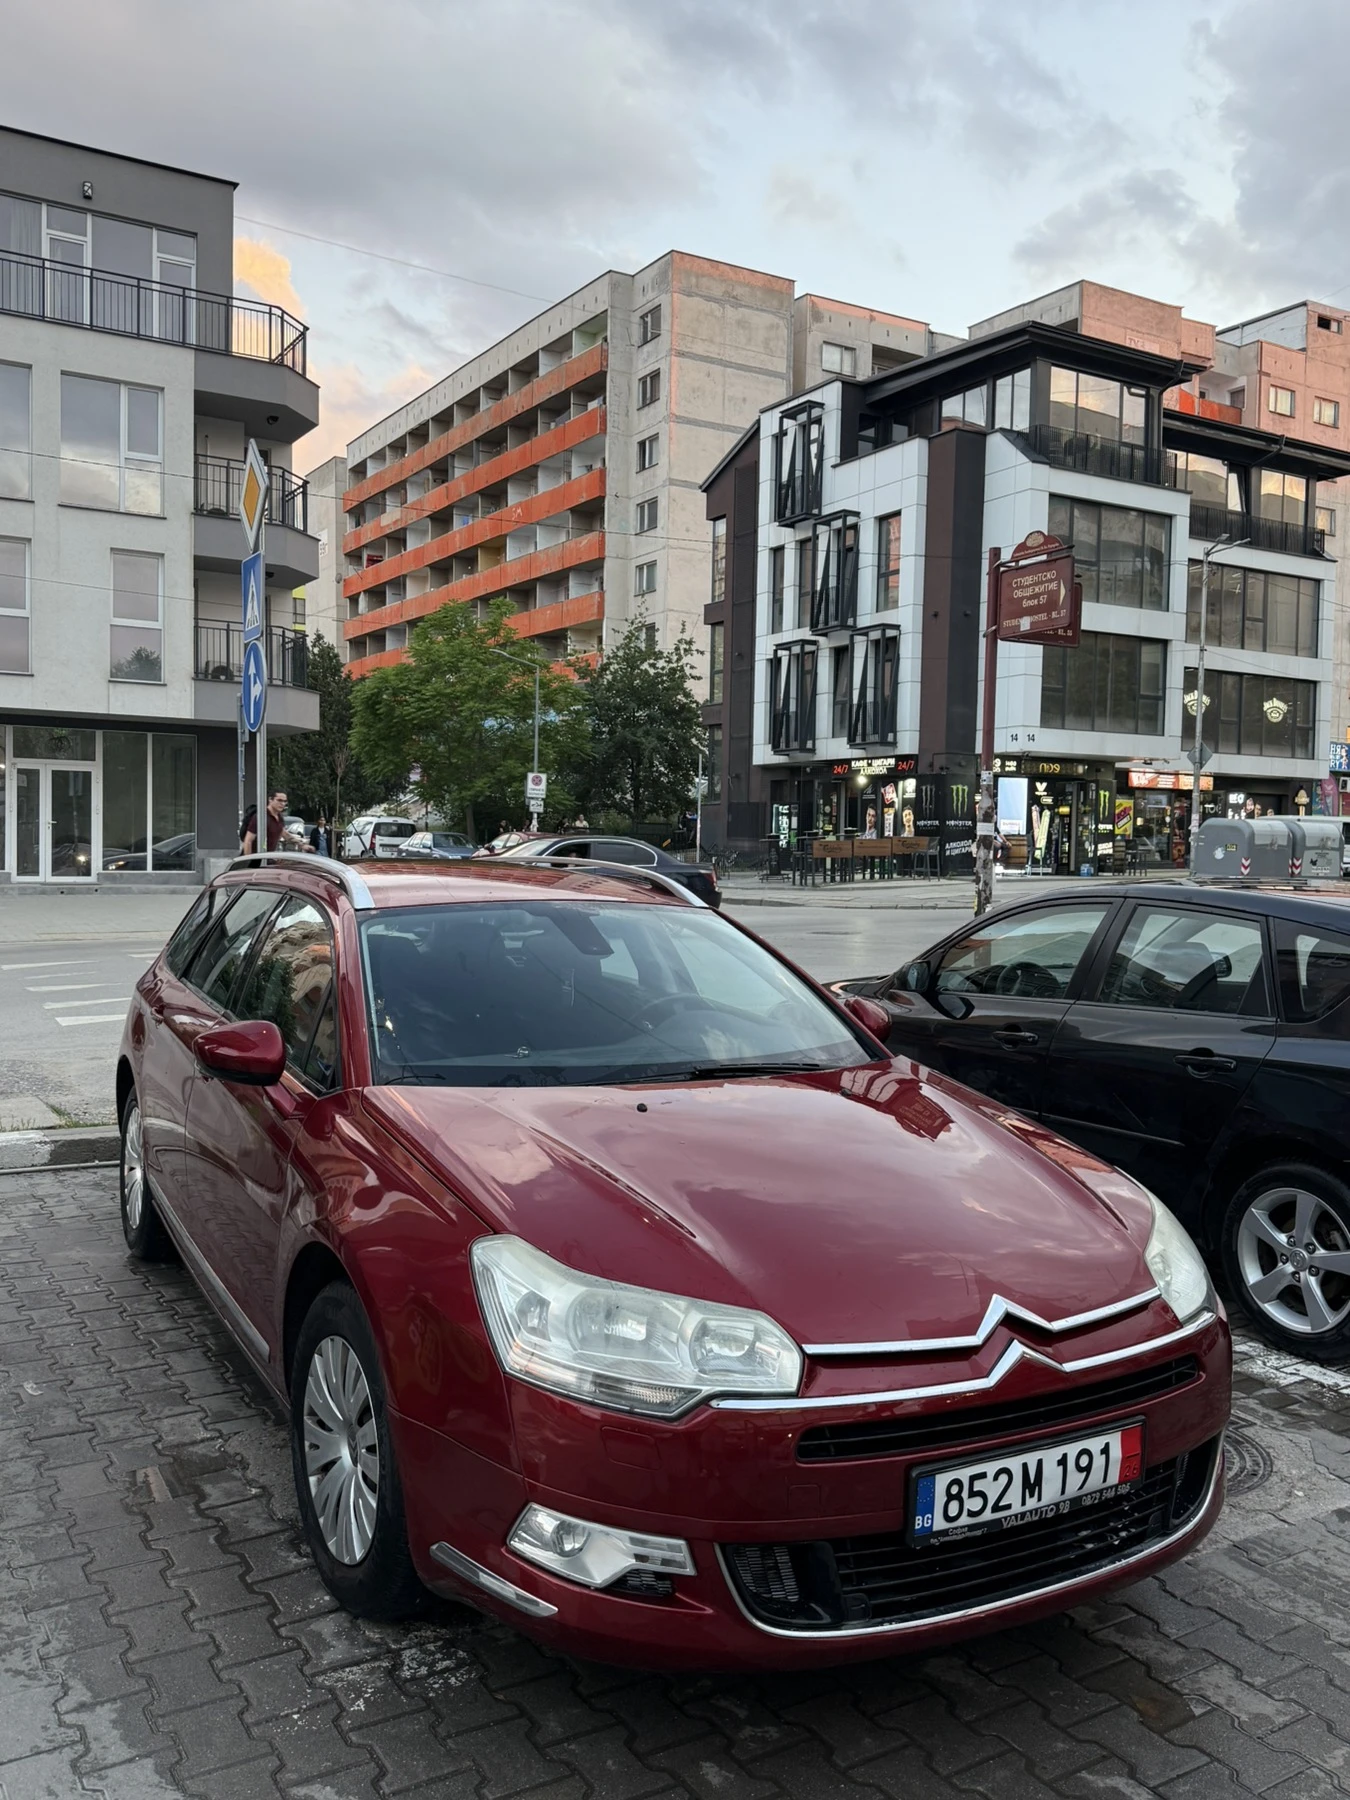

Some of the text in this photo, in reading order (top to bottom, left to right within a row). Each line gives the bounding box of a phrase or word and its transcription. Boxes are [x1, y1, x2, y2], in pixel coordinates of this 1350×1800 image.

[1012, 570, 1057, 588] СТУДЕНТСКО
[1013, 580, 1059, 599] ОБЩЕЖИТИЕ
[1022, 594, 1047, 608] блок 57
[1010, 733, 1036, 742] 14 14
[833, 764, 849, 774] 24/7
[851, 757, 896, 768] КАФЕ ЦИГАРИ
[897, 760, 915, 771] 24/7
[945, 839, 973, 850] АЛКОХОЛ
[1123, 1463, 1139, 1478] 26
[914, 1513, 932, 1530] BG
[942, 1466, 1014, 1524] 852
[1056, 1441, 1110, 1497] 191
[1001, 1504, 1056, 1529] VALAUTO
